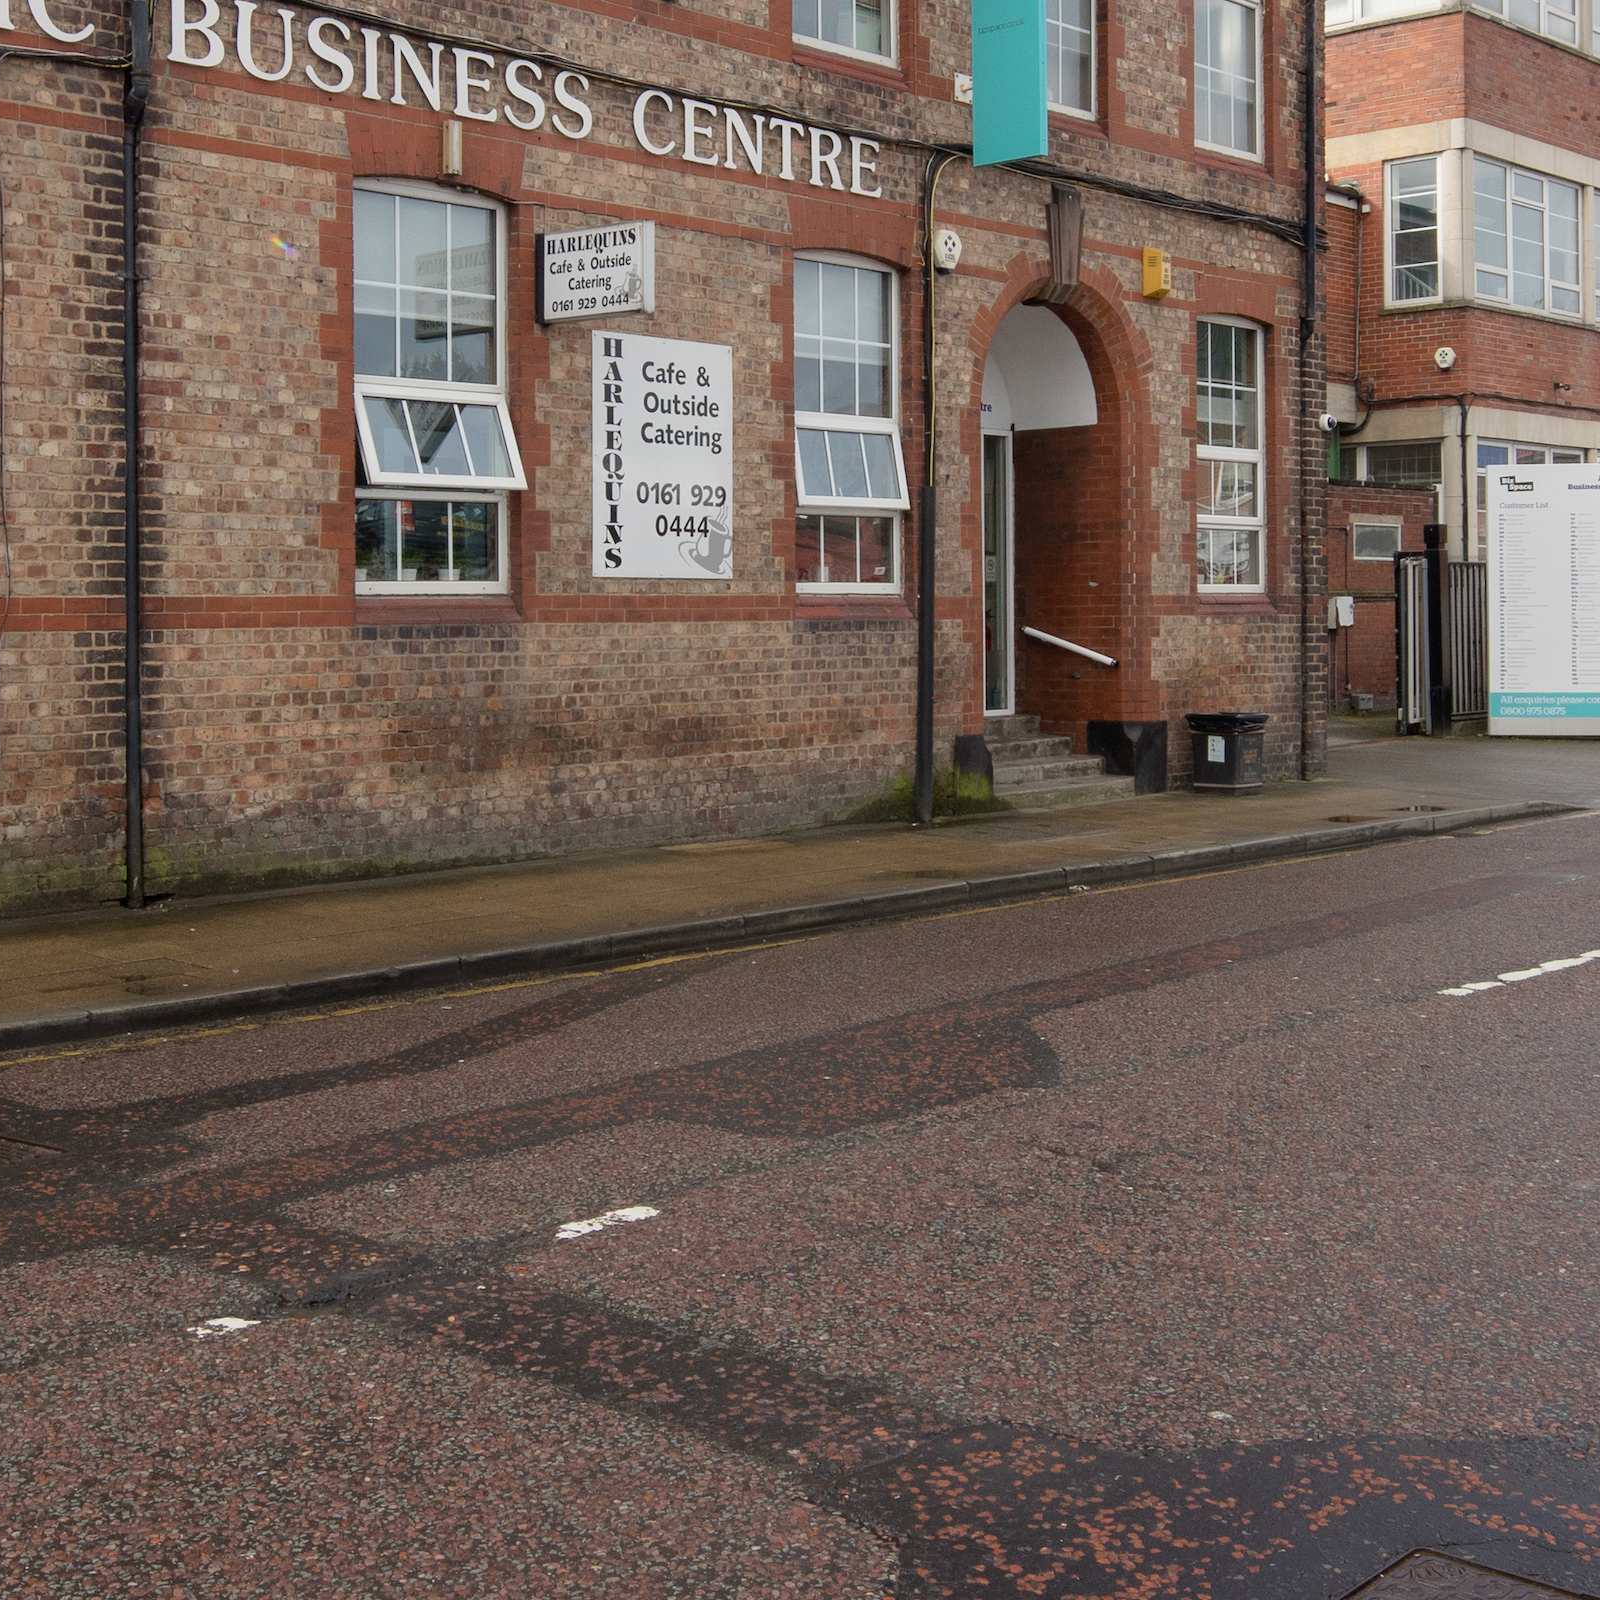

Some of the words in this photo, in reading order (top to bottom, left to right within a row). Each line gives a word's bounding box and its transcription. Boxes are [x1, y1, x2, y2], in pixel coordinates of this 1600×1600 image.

[633, 89, 883, 199] CENTRE
[546, 227, 636, 255] HARLEQUINS
[549, 259, 573, 275] Cafe
[577, 259, 586, 271] &
[590, 254, 632, 270] Outside
[568, 276, 612, 292] Catering
[551, 299, 574, 312] 0161
[578, 297, 597, 310] 929
[601, 294, 630, 307] 0444
[641, 361, 686, 385] Cafe
[696, 366, 710, 388] &
[643, 391, 719, 418] Outside
[640, 422, 722, 454] Catering
[636, 482, 681, 506] 0161
[691, 485, 727, 508] 929
[1508, 483, 1532, 491] Space
[655, 515, 709, 538] 0444
[1500, 696, 1512, 704] All
[1513, 695, 1555, 705] enquiries
[1557, 696, 1585, 705] please
[1500, 707, 1525, 715] 0800
[1526, 707, 1542, 715] 975
[1543, 707, 1566, 715] 0875
